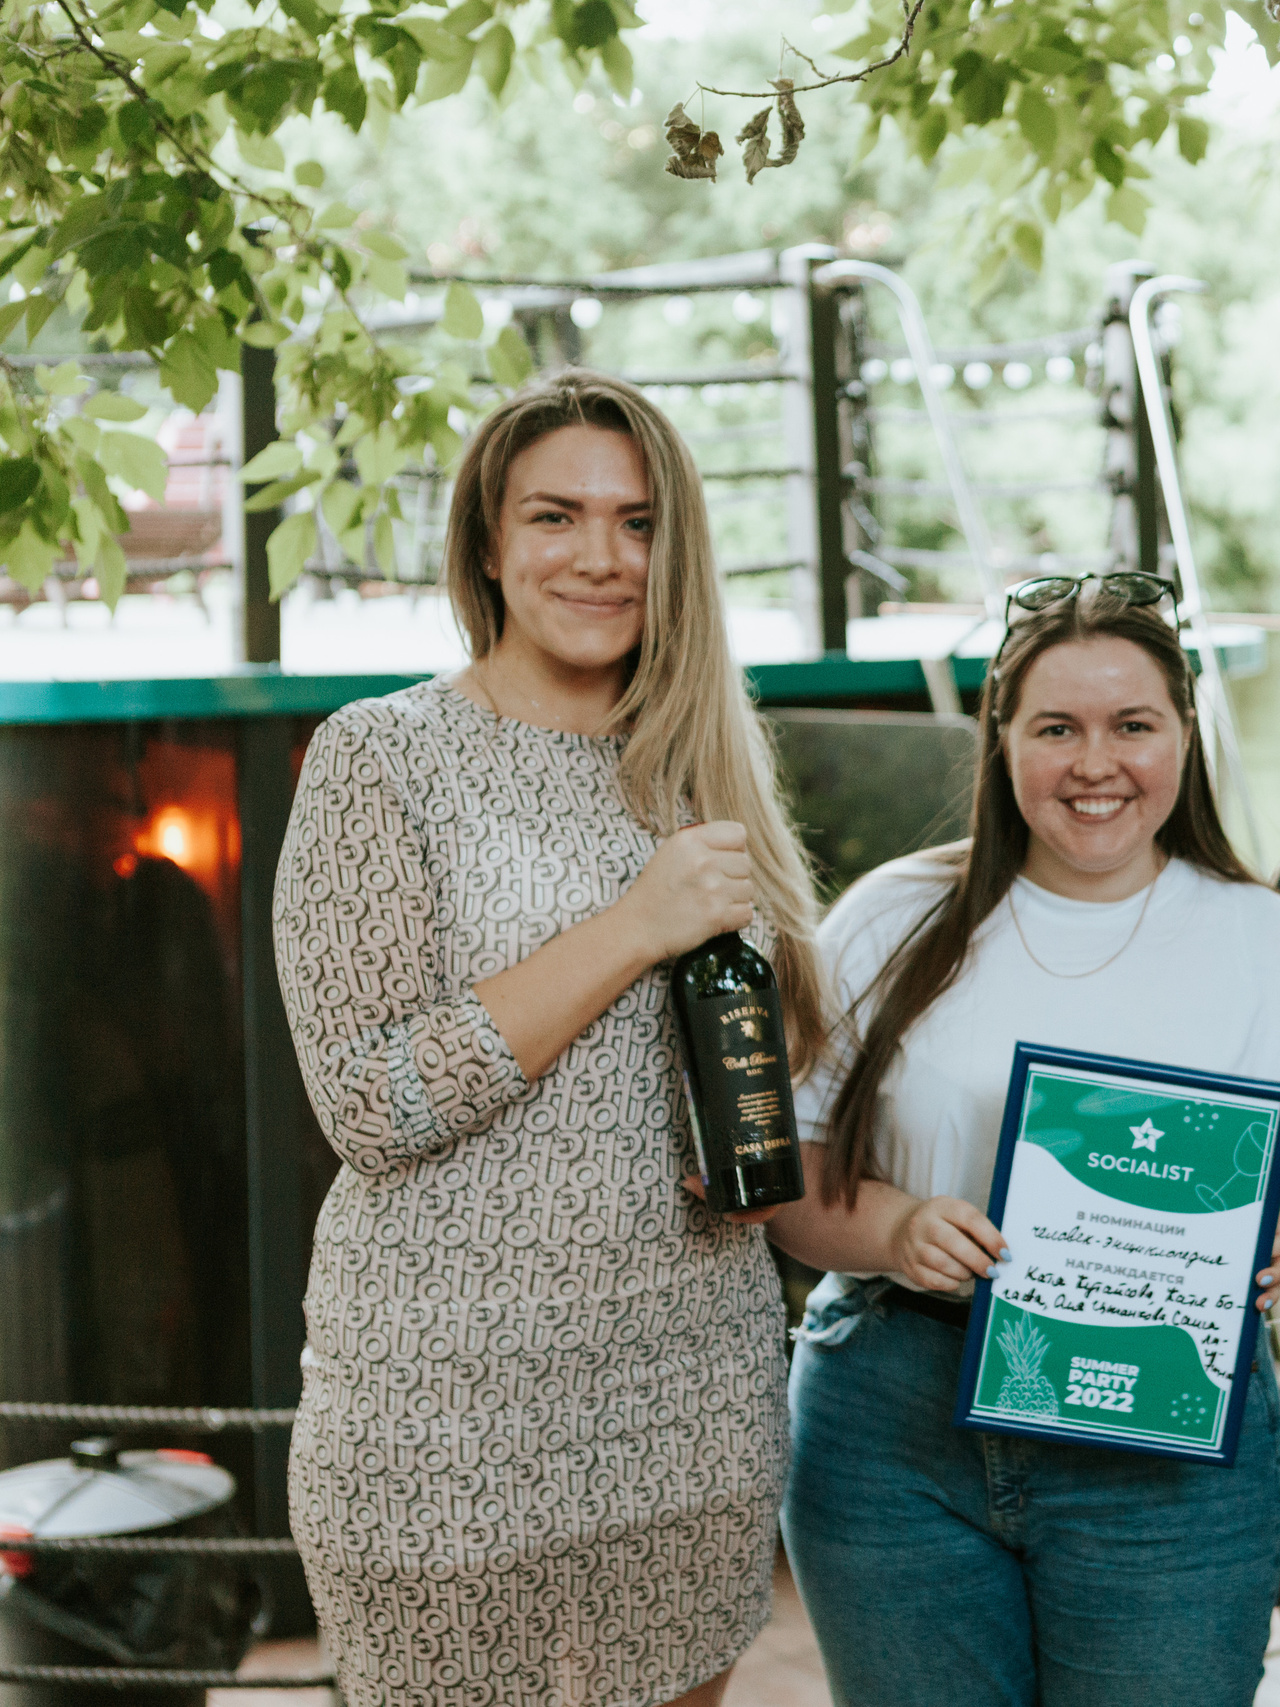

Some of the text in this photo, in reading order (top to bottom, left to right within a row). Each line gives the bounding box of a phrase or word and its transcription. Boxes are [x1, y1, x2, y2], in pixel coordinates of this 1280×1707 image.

[719, 1005, 769, 1026] RISERVA
[734, 1142, 763, 1155] CASA
[1086, 1152, 1195, 1183] SOCIALIST
[1076, 1210, 1186, 1236] В НОМИНАЦИИ
[1065, 1258, 1185, 1285] НАГРАЖДАЕТСЯ
[1070, 1356, 1140, 1377] SUMMER
[1068, 1368, 1138, 1392] PARTY
[1064, 1384, 1134, 1413] 2022
